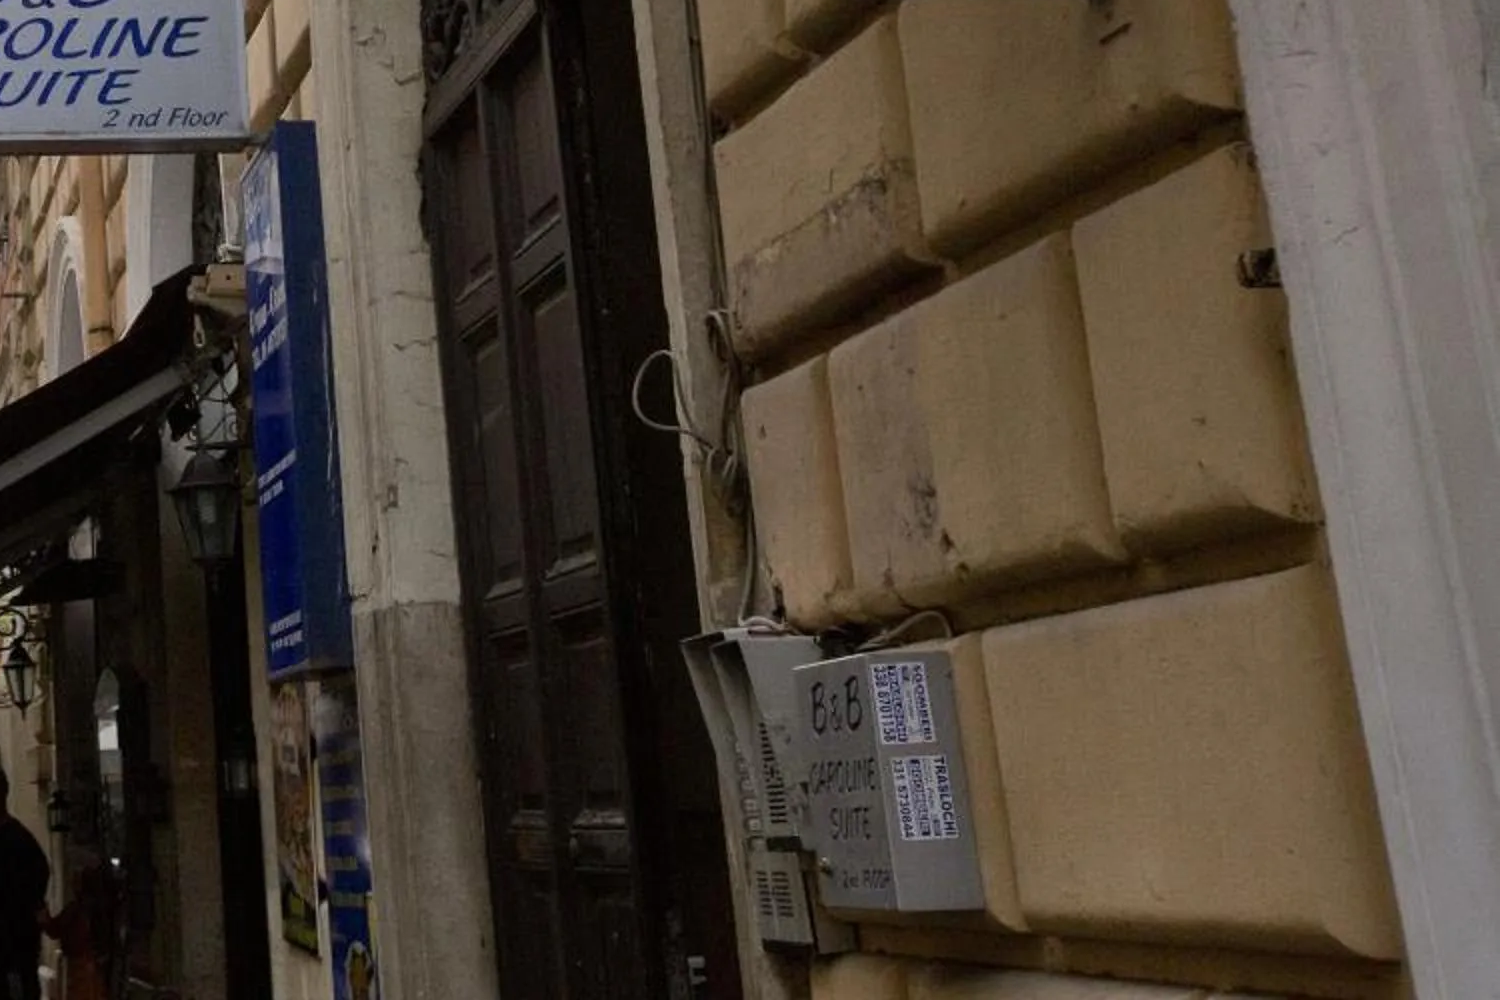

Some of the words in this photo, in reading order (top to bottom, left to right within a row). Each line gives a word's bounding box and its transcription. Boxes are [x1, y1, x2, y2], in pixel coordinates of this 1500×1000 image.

[167, 106, 229, 127] Floor
[810, 675, 862, 735] B&B
[934, 756, 957, 837] TRASLOCHI
[829, 807, 871, 840] SUITE
